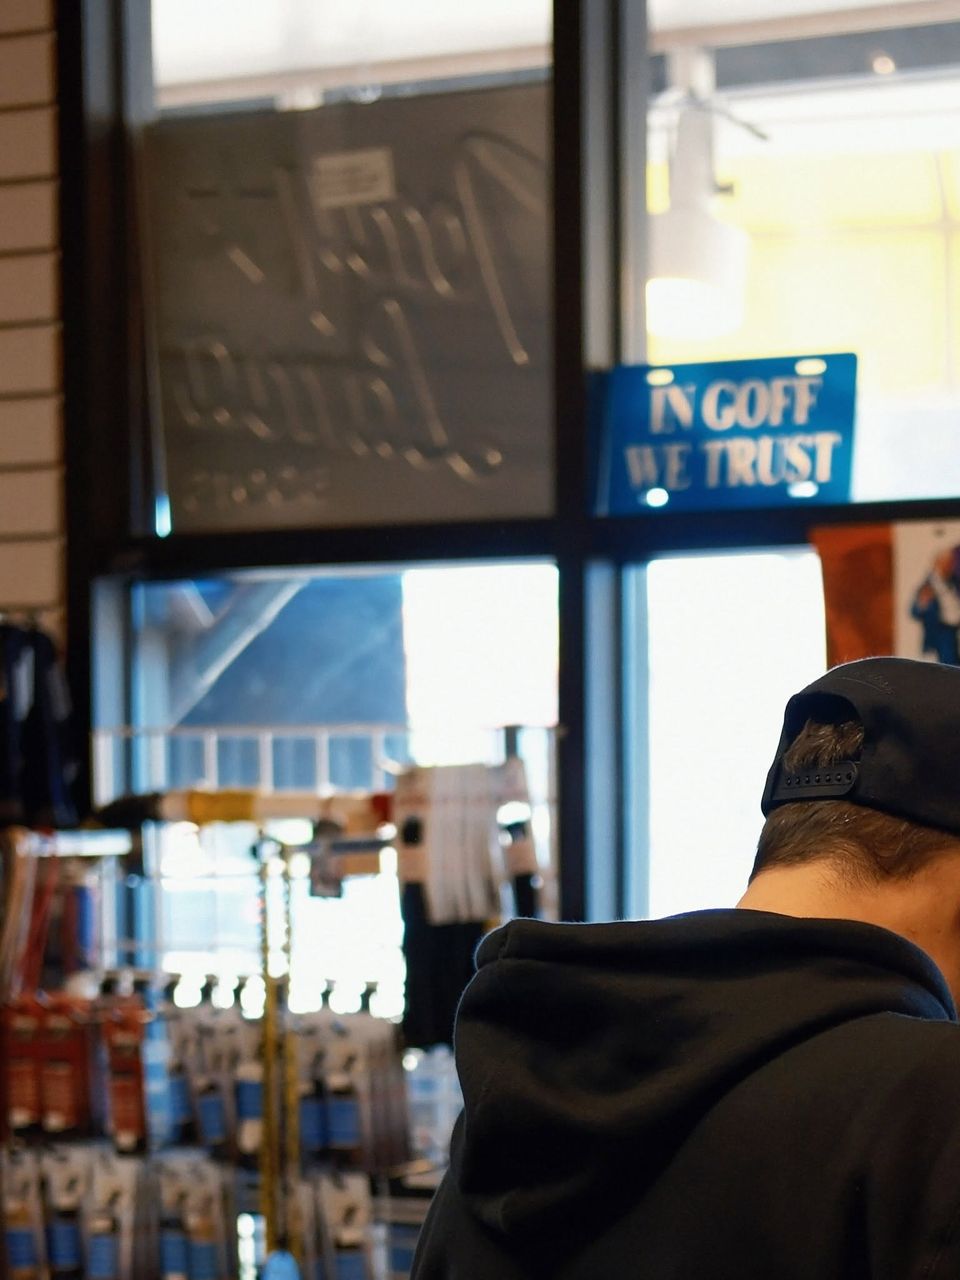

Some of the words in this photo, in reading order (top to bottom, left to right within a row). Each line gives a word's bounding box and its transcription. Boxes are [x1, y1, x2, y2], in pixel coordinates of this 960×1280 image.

[650, 383, 696, 434] IN
[702, 376, 823, 431] GOFF
[625, 444, 692, 490] WE
[704, 432, 842, 488] TRUST
